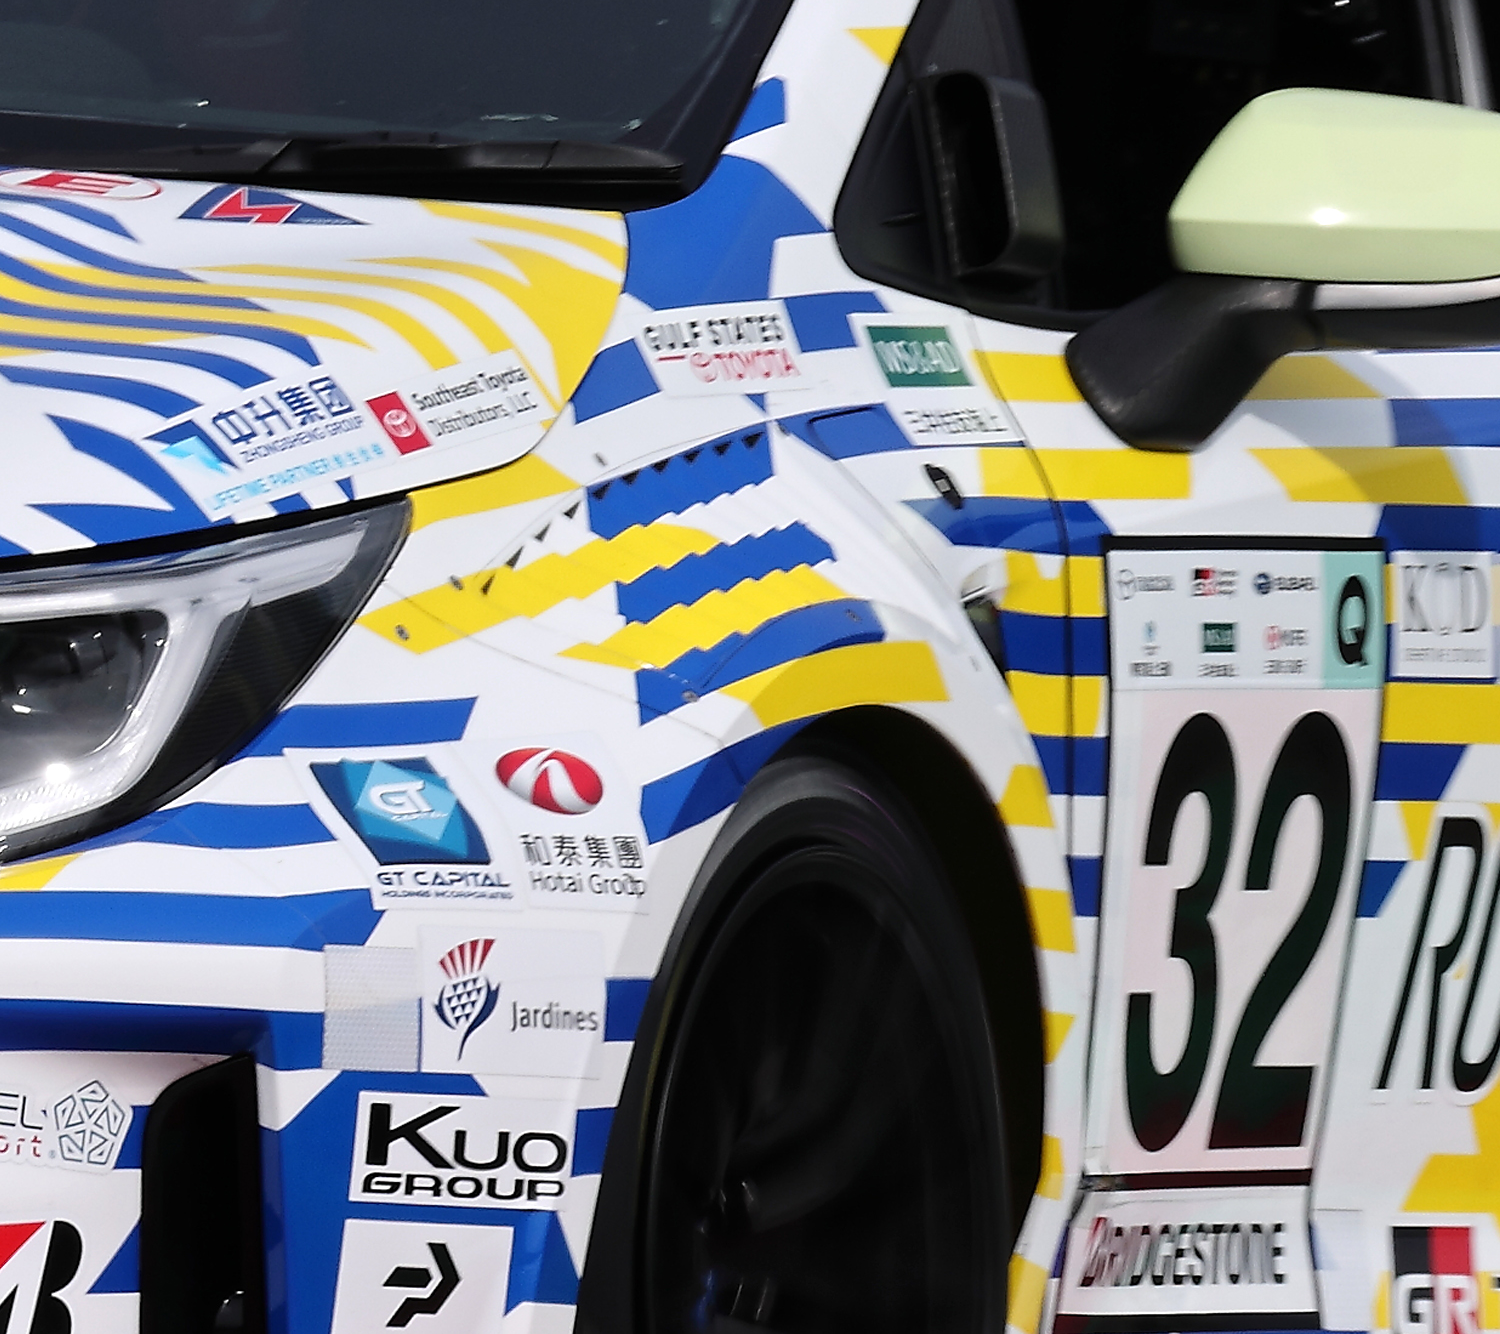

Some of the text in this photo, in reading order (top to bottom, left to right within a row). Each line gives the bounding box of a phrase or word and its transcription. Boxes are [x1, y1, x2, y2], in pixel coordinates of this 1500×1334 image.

[643, 311, 785, 352] GULF STATES
[410, 366, 530, 411] Southeast Toyota
[507, 391, 539, 414] LLC
[1337, 574, 1368, 667] Q
[368, 779, 436, 816] GT
[519, 833, 645, 870] 和泰集團
[376, 870, 512, 888] GT CAPITAL
[530, 870, 647, 900] Hotai Group
[1125, 712, 1352, 1154] 32
[509, 1000, 599, 1033] Jardines
[361, 1171, 565, 1202] GROUP
[1080, 1216, 1285, 1288] BRIDGESTONE
